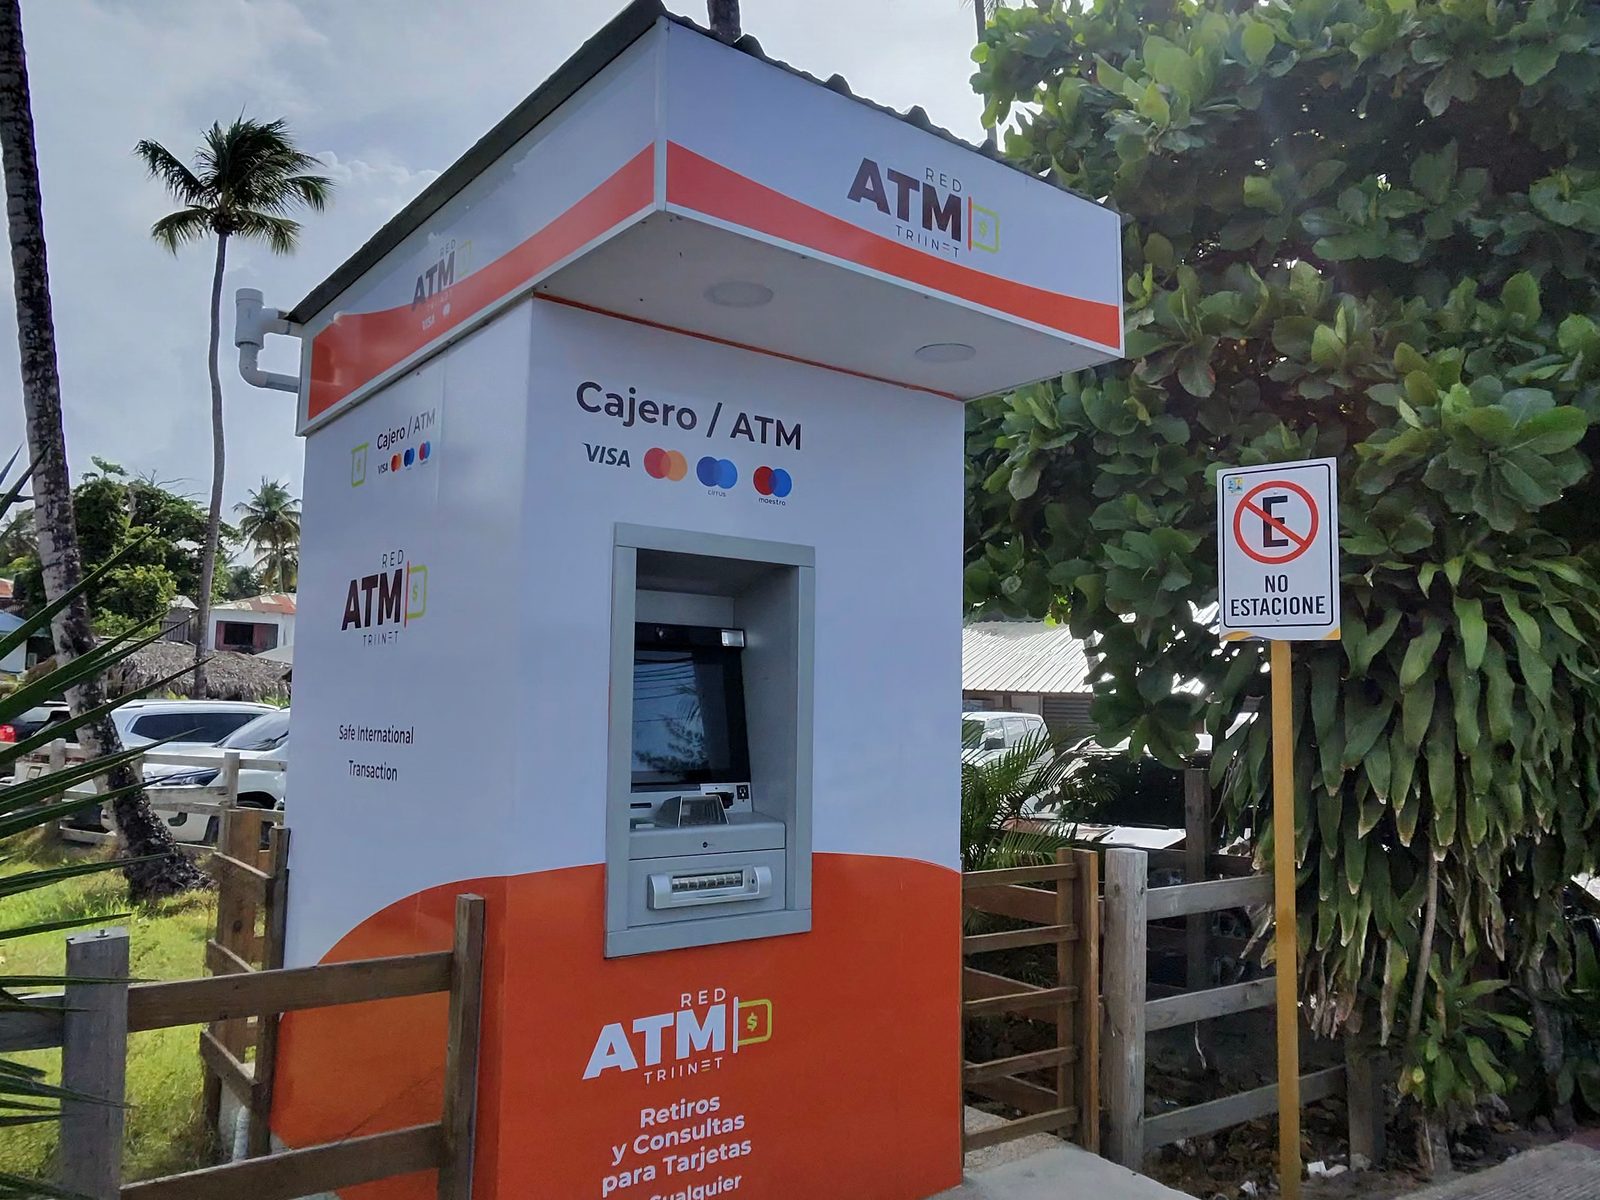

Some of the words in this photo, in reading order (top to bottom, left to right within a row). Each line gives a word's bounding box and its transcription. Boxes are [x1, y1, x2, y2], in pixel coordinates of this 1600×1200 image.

[925, 167, 962, 193] RED
[847, 157, 962, 242] ATM
[412, 250, 455, 312] ATM
[576, 381, 697, 430] Cajero
[706, 402, 723, 438] /
[729, 412, 801, 450] ATM
[377, 426, 405, 450] Cajero
[413, 408, 435, 434] ATM
[582, 442, 631, 468] VISA
[707, 489, 727, 498] cirrus
[758, 497, 786, 506] maestro
[382, 549, 404, 568] RED
[1264, 575, 1288, 593] NO
[341, 568, 403, 631] ATM
[1231, 596, 1325, 617] ESTACIONE
[339, 724, 356, 740] Safe
[358, 724, 414, 744] International
[349, 760, 398, 781] Transaction
[681, 987, 727, 1008] RED
[582, 1004, 726, 1080] ATM
[640, 1096, 720, 1129] Retiros
[612, 1143, 627, 1166] y
[633, 1114, 745, 1155] Consultas
[602, 1165, 656, 1199] para
[663, 1139, 752, 1176] Tarjetas
